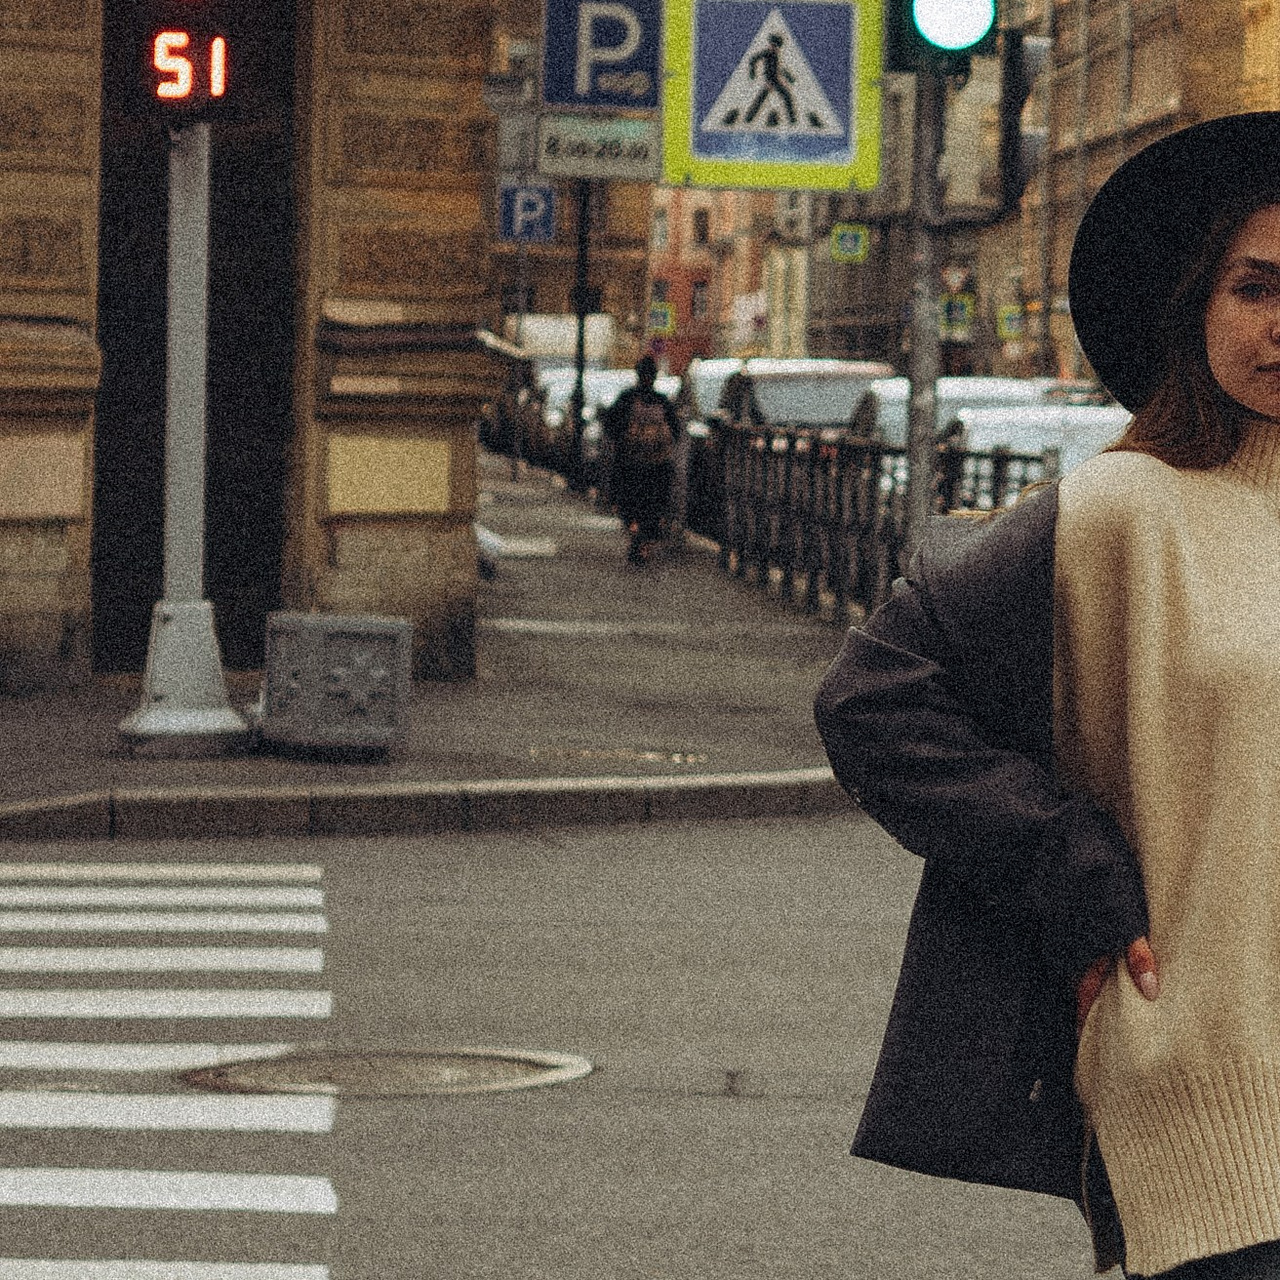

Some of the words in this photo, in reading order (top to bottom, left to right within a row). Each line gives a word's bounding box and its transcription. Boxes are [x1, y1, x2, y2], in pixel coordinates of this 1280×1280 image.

[153, 30, 227, 99] 51
[576, 2, 642, 96] P
[513, 190, 546, 235] P
